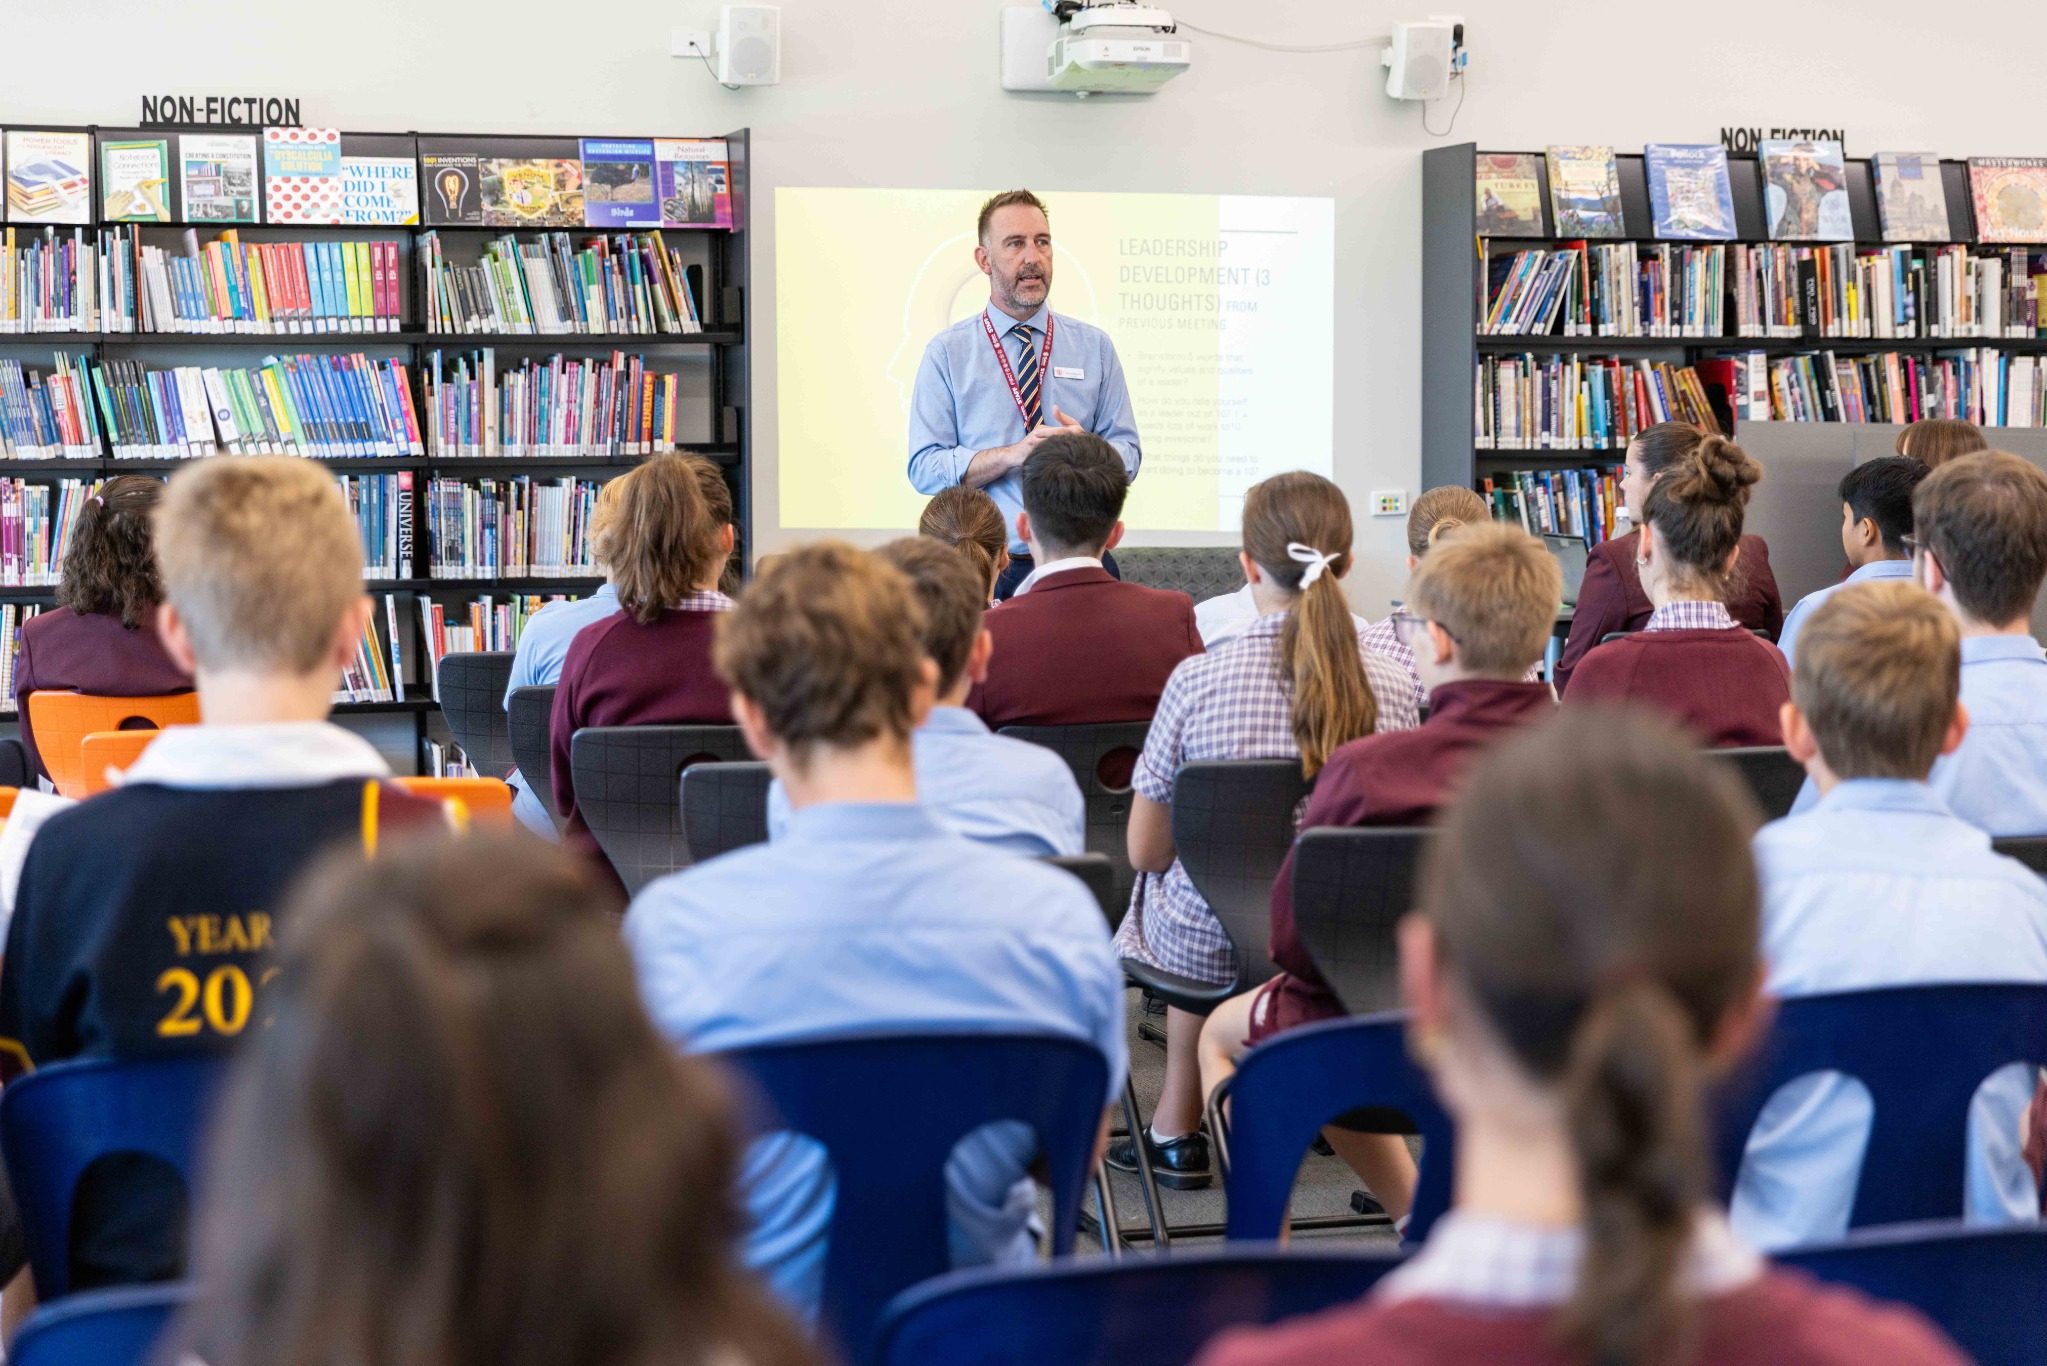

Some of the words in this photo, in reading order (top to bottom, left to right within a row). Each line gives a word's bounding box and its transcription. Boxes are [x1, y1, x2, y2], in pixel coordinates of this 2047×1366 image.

[142, 95, 300, 124] NON-FICTION
[438, 156, 476, 164] INVENTIONS
[344, 180, 375, 193] DID
[380, 181, 387, 193] I
[344, 195, 397, 208] COME
[611, 206, 634, 217] Birds
[1119, 238, 1229, 257] LEADERSHIP
[1119, 264, 1251, 286] DEVELOPMENT
[1255, 267, 1271, 288] (3
[1118, 292, 1221, 313] THOUGHTS)
[1225, 300, 1259, 313] FROM
[1119, 317, 1174, 330] PREVIOUS
[1176, 317, 1227, 331] MEETING
[399, 491, 414, 558] UNIVERSE
[167, 909, 274, 957] YEAR
[155, 962, 282, 1037] 20
